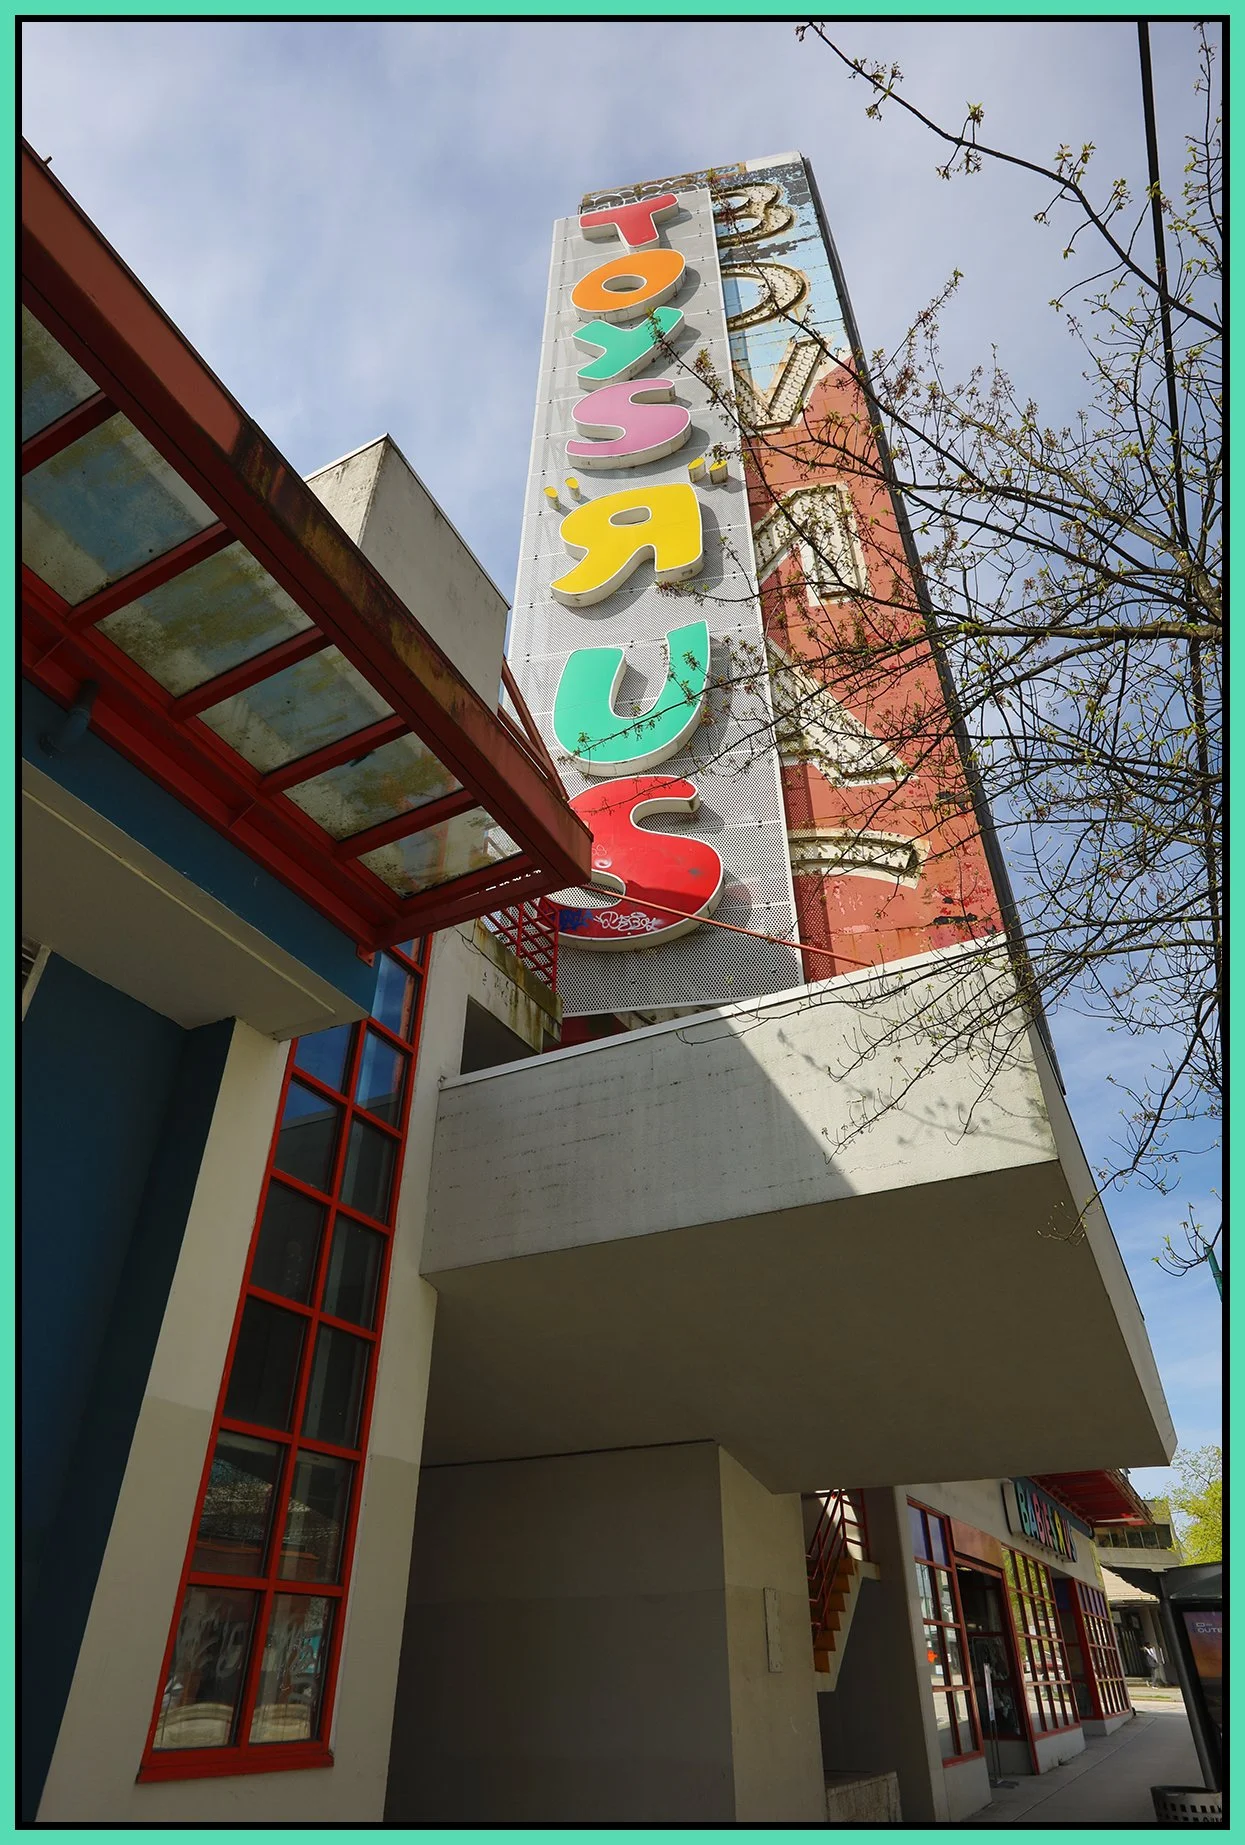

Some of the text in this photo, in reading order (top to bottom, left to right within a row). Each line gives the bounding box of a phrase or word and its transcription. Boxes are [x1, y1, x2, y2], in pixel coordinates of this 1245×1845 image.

[564, 192, 692, 470] TOYS
[536, 619, 725, 953] US
[1016, 1481, 1059, 1553] BABIES
